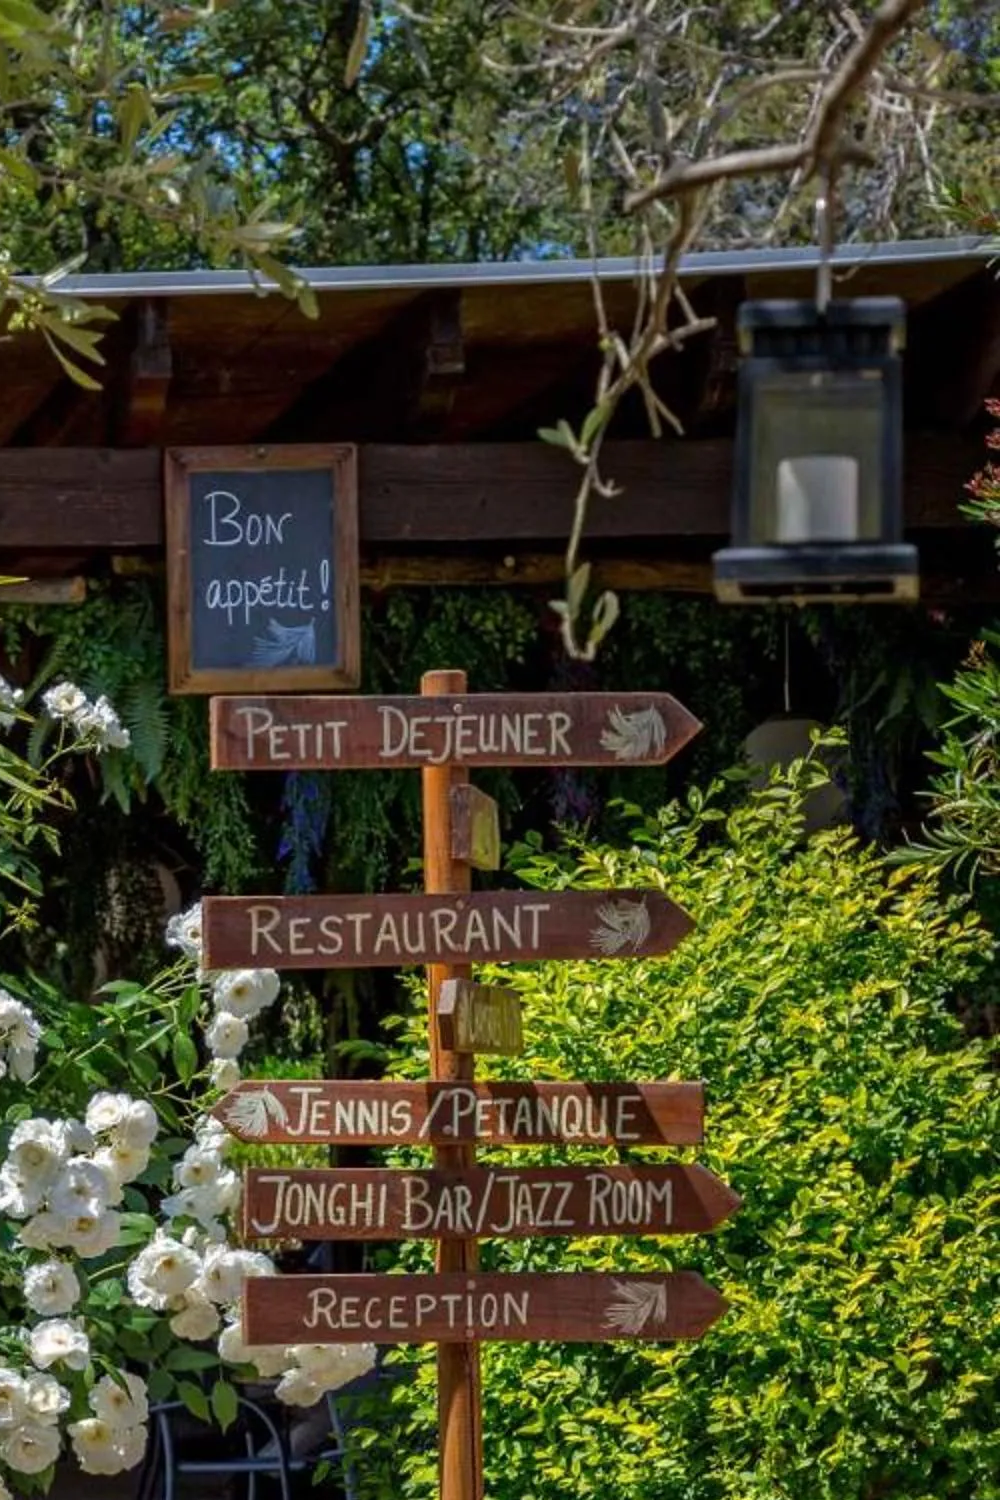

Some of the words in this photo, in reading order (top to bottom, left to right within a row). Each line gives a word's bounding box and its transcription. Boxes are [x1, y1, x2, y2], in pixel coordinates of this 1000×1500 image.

[236, 706, 348, 760] PETIT
[247, 905, 550, 955] RESTAURANT
[585, 1173, 672, 1226] ROOM
[303, 1287, 529, 1329] RECEPTION
